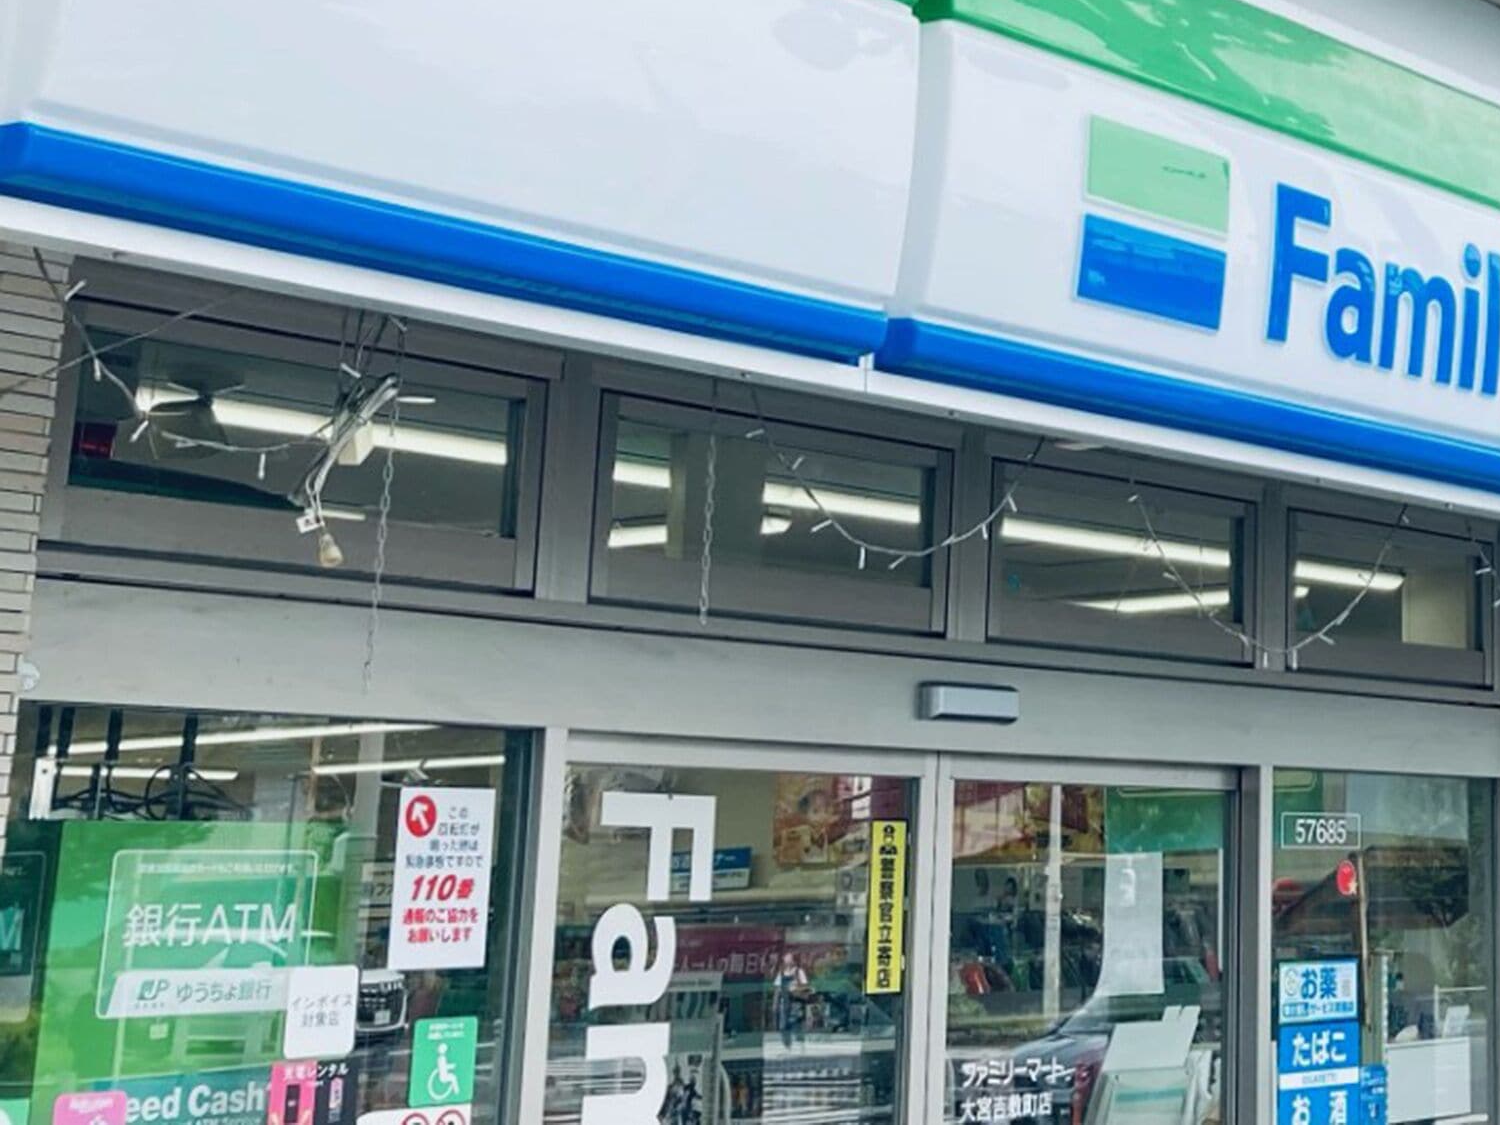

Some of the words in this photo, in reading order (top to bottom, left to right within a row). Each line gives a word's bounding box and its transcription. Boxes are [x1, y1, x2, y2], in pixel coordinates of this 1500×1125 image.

[1294, 818, 1347, 845] 57685
[411, 874, 475, 902] 110番
[123, 903, 297, 947] 銀行ATM
[407, 927, 473, 944] お願いします
[175, 979, 273, 1004] ゆうちょ銀行
[1301, 967, 1337, 999] お薬
[291, 994, 354, 1009] インボイス
[1292, 1029, 1347, 1066] たばこ
[961, 1056, 1068, 1087] ファミリーマート
[126, 1088, 183, 1123] eed
[187, 1081, 267, 1117] Cash
